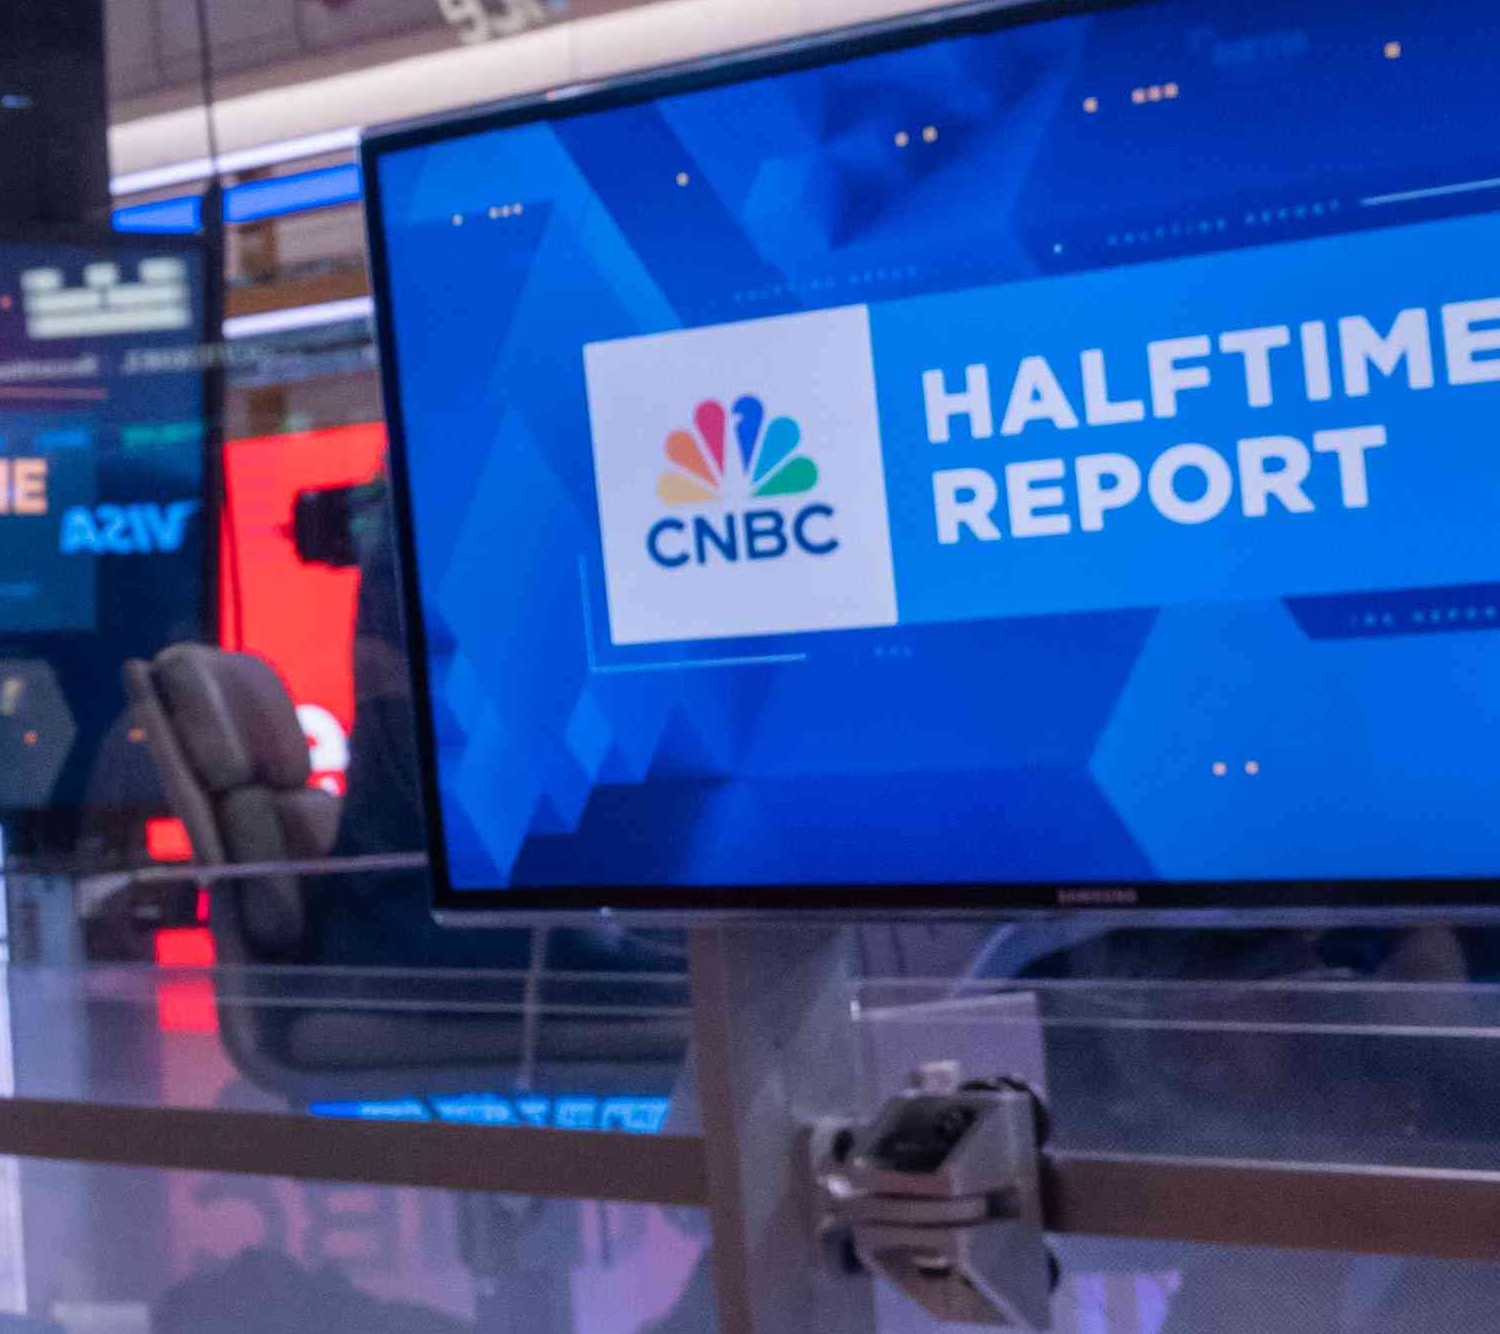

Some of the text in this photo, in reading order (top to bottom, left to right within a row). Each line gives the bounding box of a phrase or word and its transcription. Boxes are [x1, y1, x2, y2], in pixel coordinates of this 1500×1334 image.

[920, 297, 1500, 444] HALFTIME
[646, 502, 840, 569] CNBC
[931, 424, 1389, 545] REPORT
